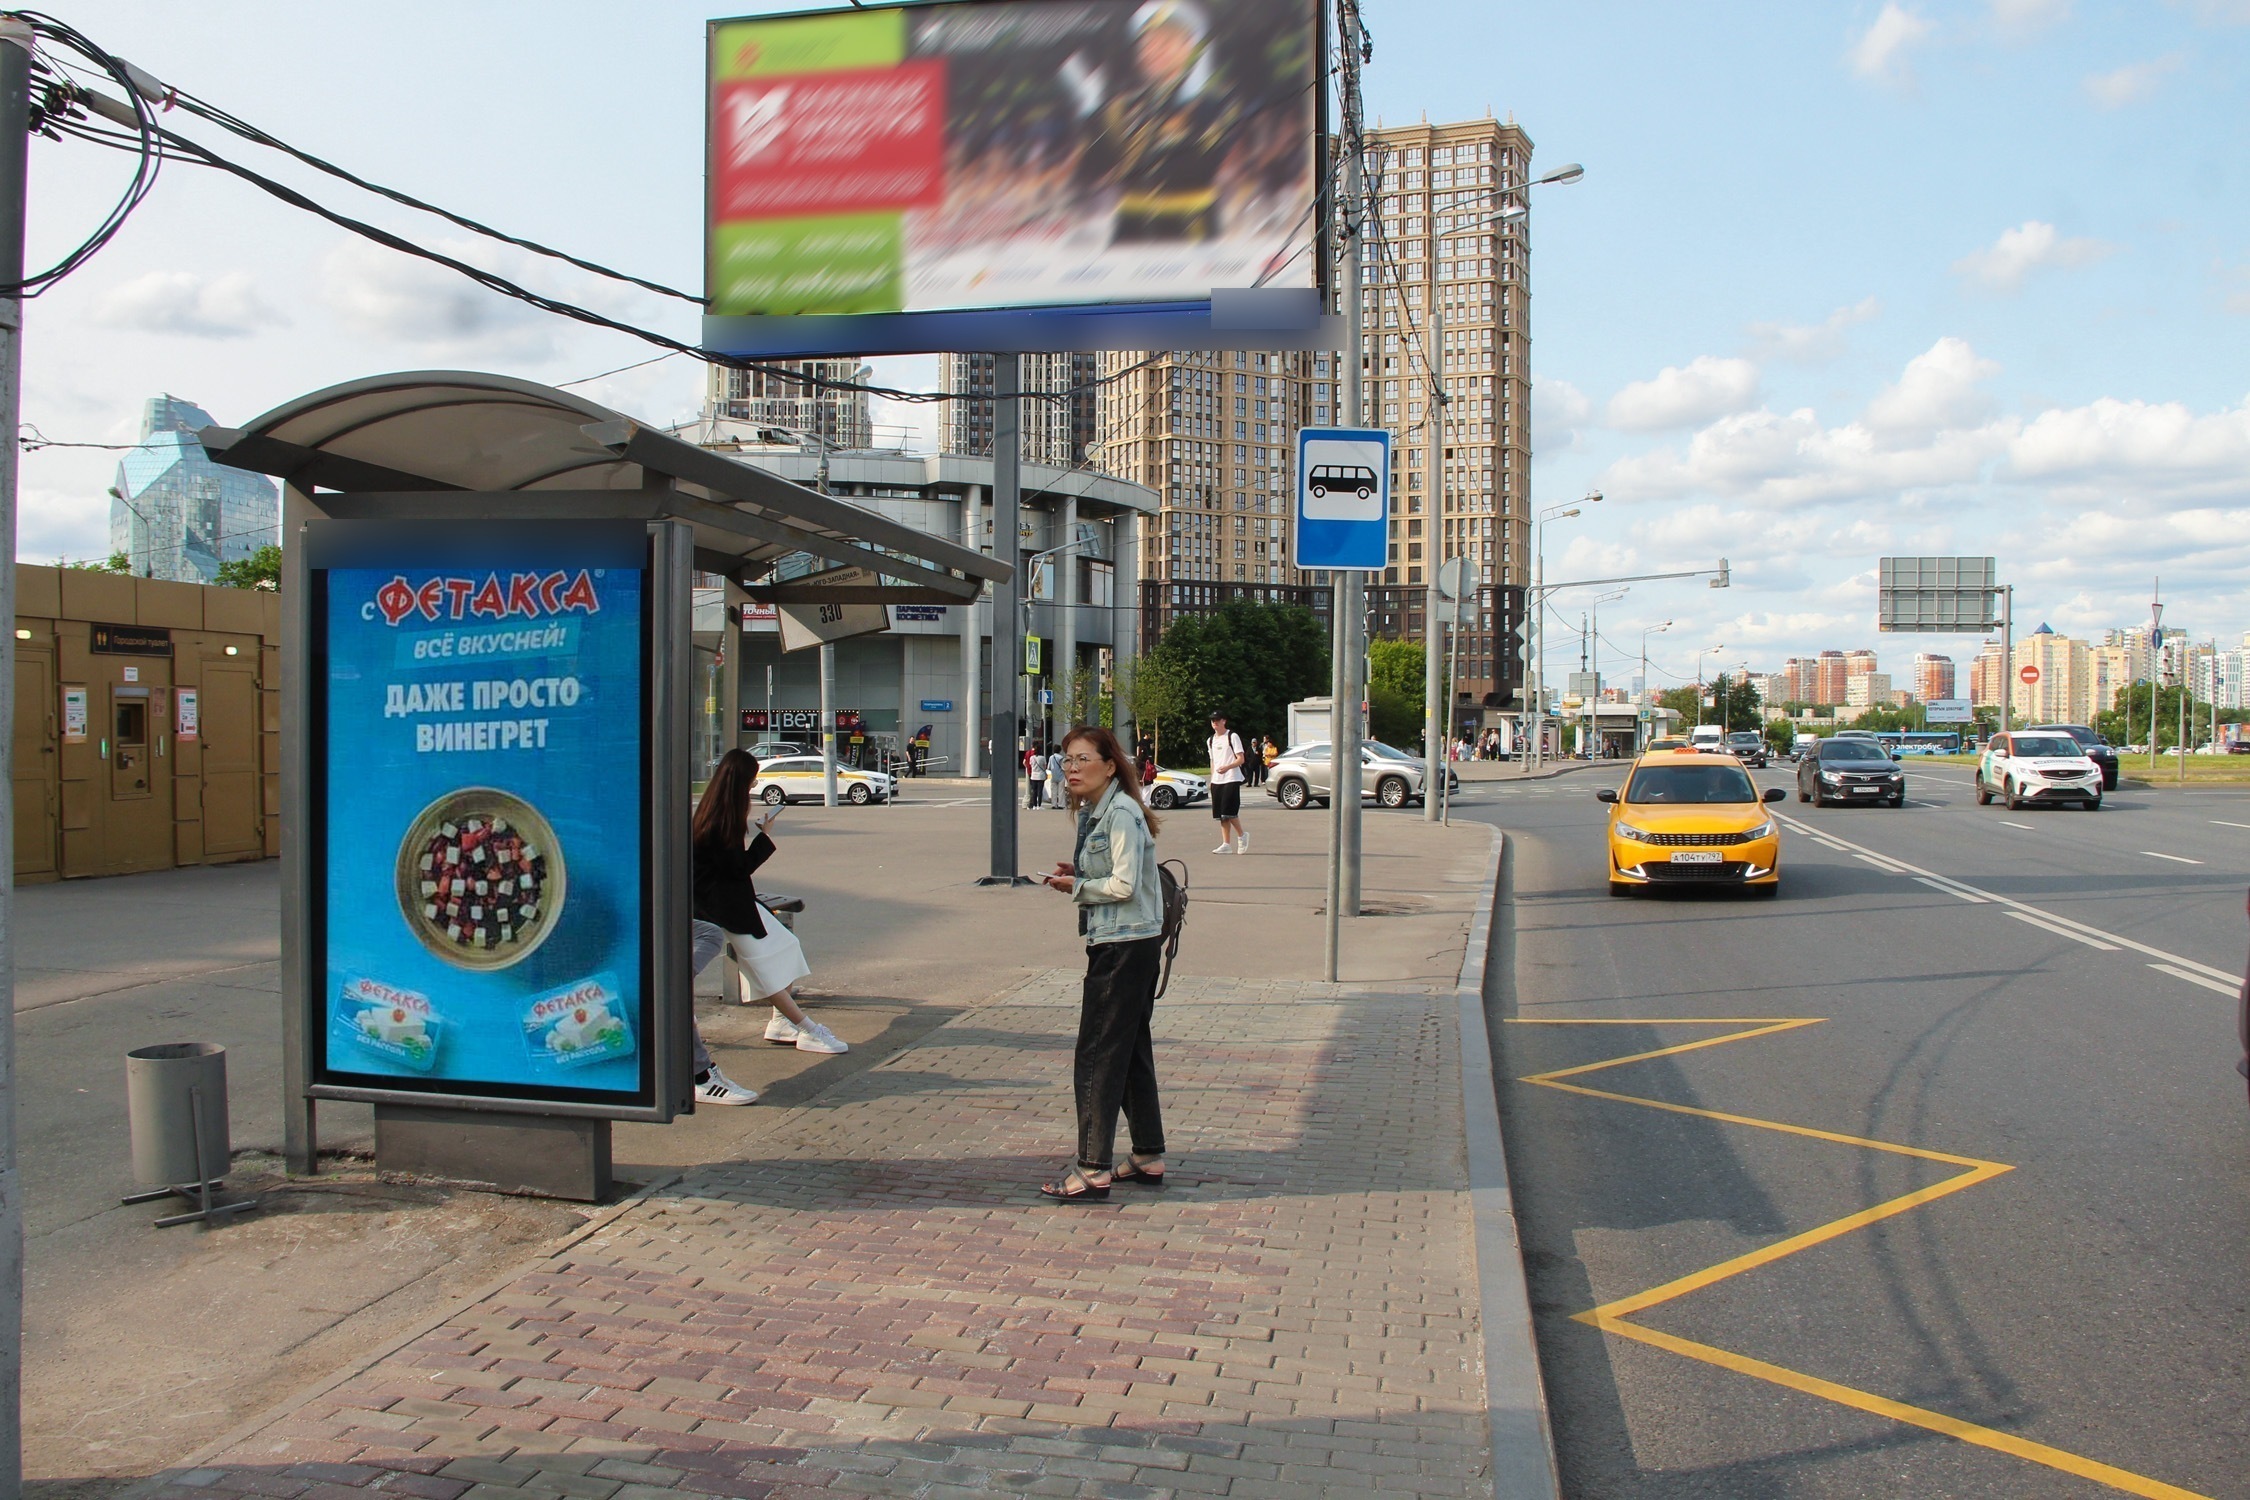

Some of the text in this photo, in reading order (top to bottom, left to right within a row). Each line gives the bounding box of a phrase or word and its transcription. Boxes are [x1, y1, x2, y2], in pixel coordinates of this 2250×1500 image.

[376, 569, 600, 627] ФЕТАКСА
[819, 603, 843, 624] 330
[413, 621, 567, 660] ВСЁ ВКУСНЕЙ!
[384, 676, 580, 719] ДАЖЕ ПРОСТО
[416, 718, 550, 753] ВИНЕГРЕТ
[358, 978, 431, 1016] ФЕТАКСА
[532, 984, 605, 1019] ФЕТАКСА
